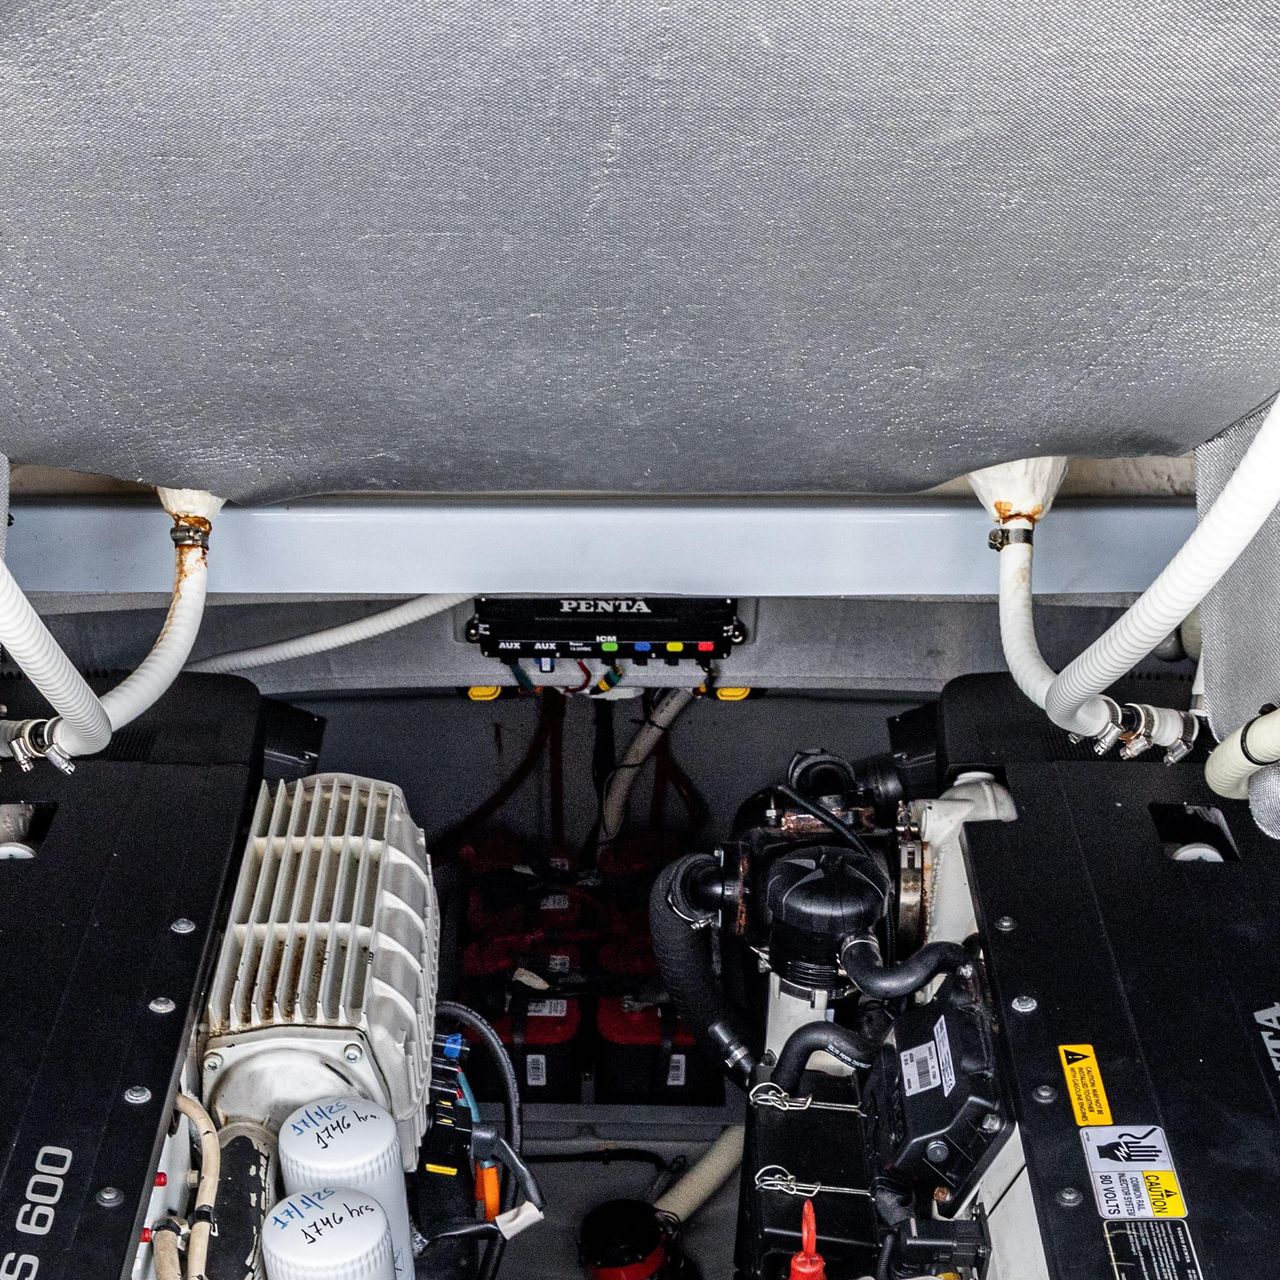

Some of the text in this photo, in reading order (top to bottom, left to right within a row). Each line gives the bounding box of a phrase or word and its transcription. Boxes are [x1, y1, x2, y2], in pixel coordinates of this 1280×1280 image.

[560, 600, 652, 613] PENTA
[499, 642, 521, 650] AUX
[534, 642, 556, 650] AUX
[1077, 1067, 1094, 1112] INSTALLED TOGETHER
[316, 1115, 351, 1149] 1746
[15, 1146, 72, 1235] 600
[1099, 1174, 1120, 1214] 80 VOLTS
[1117, 1173, 1135, 1215] INJECTOR SYSTEM
[1129, 1177, 1142, 1198] COMMON
[1135, 1200, 1145, 1210] RAIL
[1145, 1175, 1167, 1213] CAUTION
[301, 1203, 374, 1244] 1746 hrs
[1176, 1226, 1191, 1262] VOLVO PENTA
